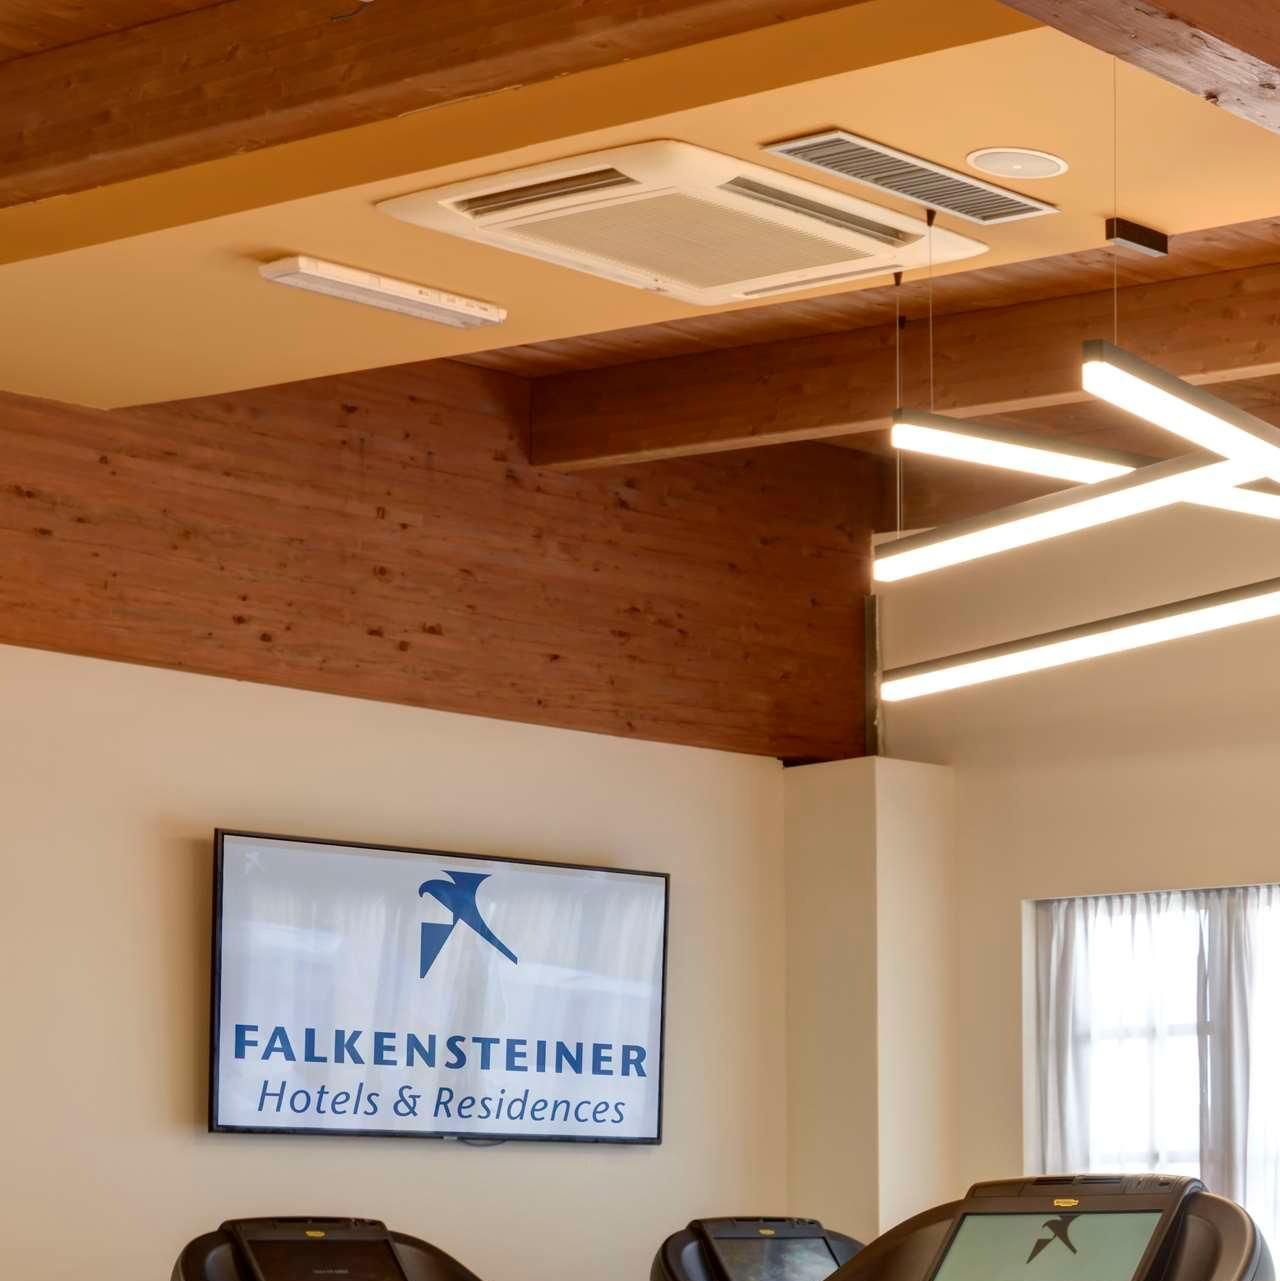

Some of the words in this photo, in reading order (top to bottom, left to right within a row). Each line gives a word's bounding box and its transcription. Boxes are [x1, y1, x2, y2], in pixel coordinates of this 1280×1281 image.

[233, 1023, 648, 1078] FALKENSTEINER
[257, 1079, 380, 1116] Hotels
[392, 1084, 420, 1118] &
[432, 1086, 626, 1125] Residences
